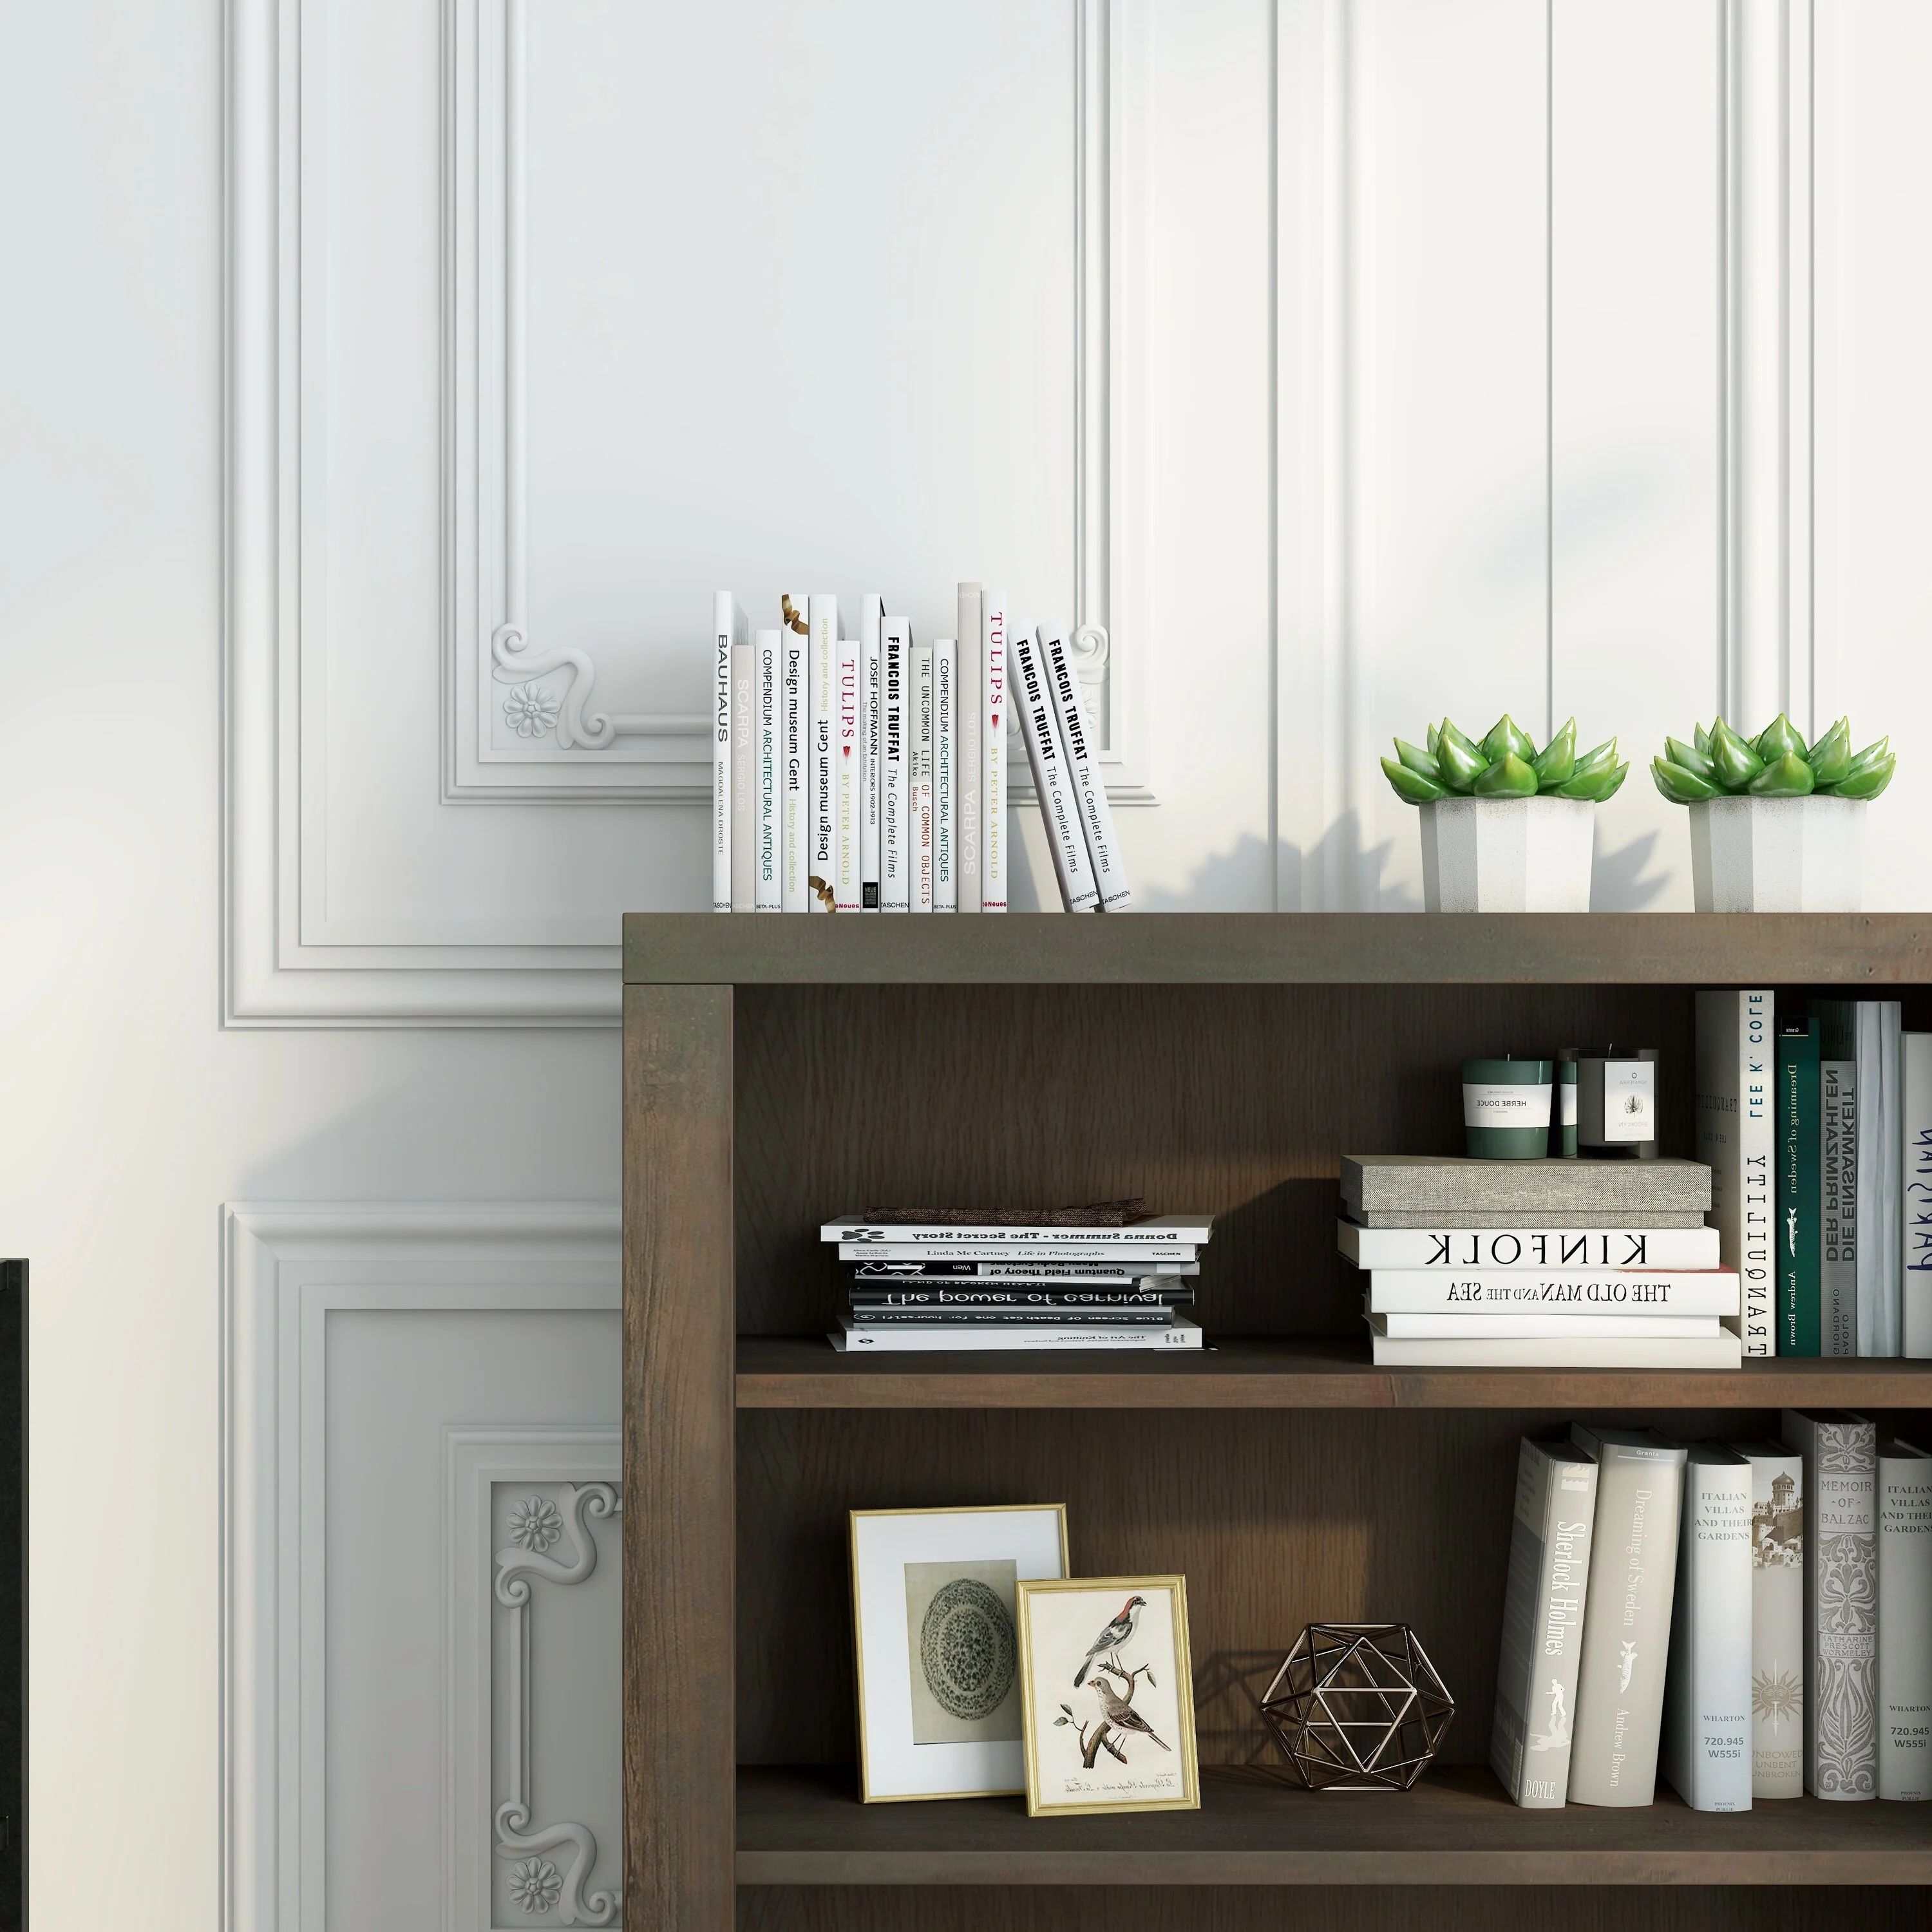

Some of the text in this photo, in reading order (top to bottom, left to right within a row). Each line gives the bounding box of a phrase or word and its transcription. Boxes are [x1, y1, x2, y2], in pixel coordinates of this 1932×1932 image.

[990, 611, 1003, 704] TULIPS
[786, 650, 800, 694] Design
[870, 656, 878, 688] JOSEF
[718, 634, 728, 743] BAUHAUS
[842, 659, 855, 737] TULIPS
[737, 677, 751, 750] SCARPA
[789, 699, 797, 753] museum
[870, 692, 878, 755] HOFFMANN
[862, 744, 867, 753] an
[761, 649, 772, 881] COMPENDIUM ARCHITECTURAL ANTIQUES
[886, 638, 899, 878] FRANCOIS TRUFFAT The Complete Films
[1016, 639, 1079, 875] FRANCOIS TRUFFAT The Complete Films
[789, 759, 800, 791] Gent
[842, 774, 849, 788] BY
[921, 658, 930, 904] THE UNCOMMON LIFE OF COMMON OBJECTS
[817, 719, 831, 860] Design museum Gent
[788, 799, 797, 829] History
[964, 790, 977, 874] SCARPA
[1069, 889, 1099, 905] TASCHEN
[1101, 889, 1131, 905] TASCHEN
[933, 902, 957, 911] BETA-PLUS
[1004, 1267, 1042, 1276] Theory
[1074, 1267, 1126, 1276] Quantum
[1636, 1449, 1661, 1458] Granta
[1821, 1481, 1872, 1492] MEMOIR
[1888, 1486, 1932, 1494] ITALIAN
[1701, 1492, 1747, 1501] ITALIAN
[1891, 1499, 1931, 1507] VILLAS
[1704, 1506, 1745, 1514] VILLAS
[1880, 1511, 1932, 1520] AND THEI
[1694, 1519, 1752, 1528] AND THEIR
[1821, 1513, 1870, 1525] BALZAC
[1698, 1531, 1750, 1540] GARDENS
[1622, 1488, 1653, 1627] Dreaming of Sweden
[1543, 1520, 1587, 1657] Sherlock Holmes
[1890, 1727, 1930, 1736] 720.945
[1609, 1707, 1631, 1788] Andrew Brown
[1704, 1737, 1744, 1746] 720.945
[1894, 1739, 1927, 1748] W555i
[1708, 1749, 1741, 1758] W555i
[1755, 1760, 1797, 1769] UNBENT
[1524, 1777, 1558, 1801] DOYLE
